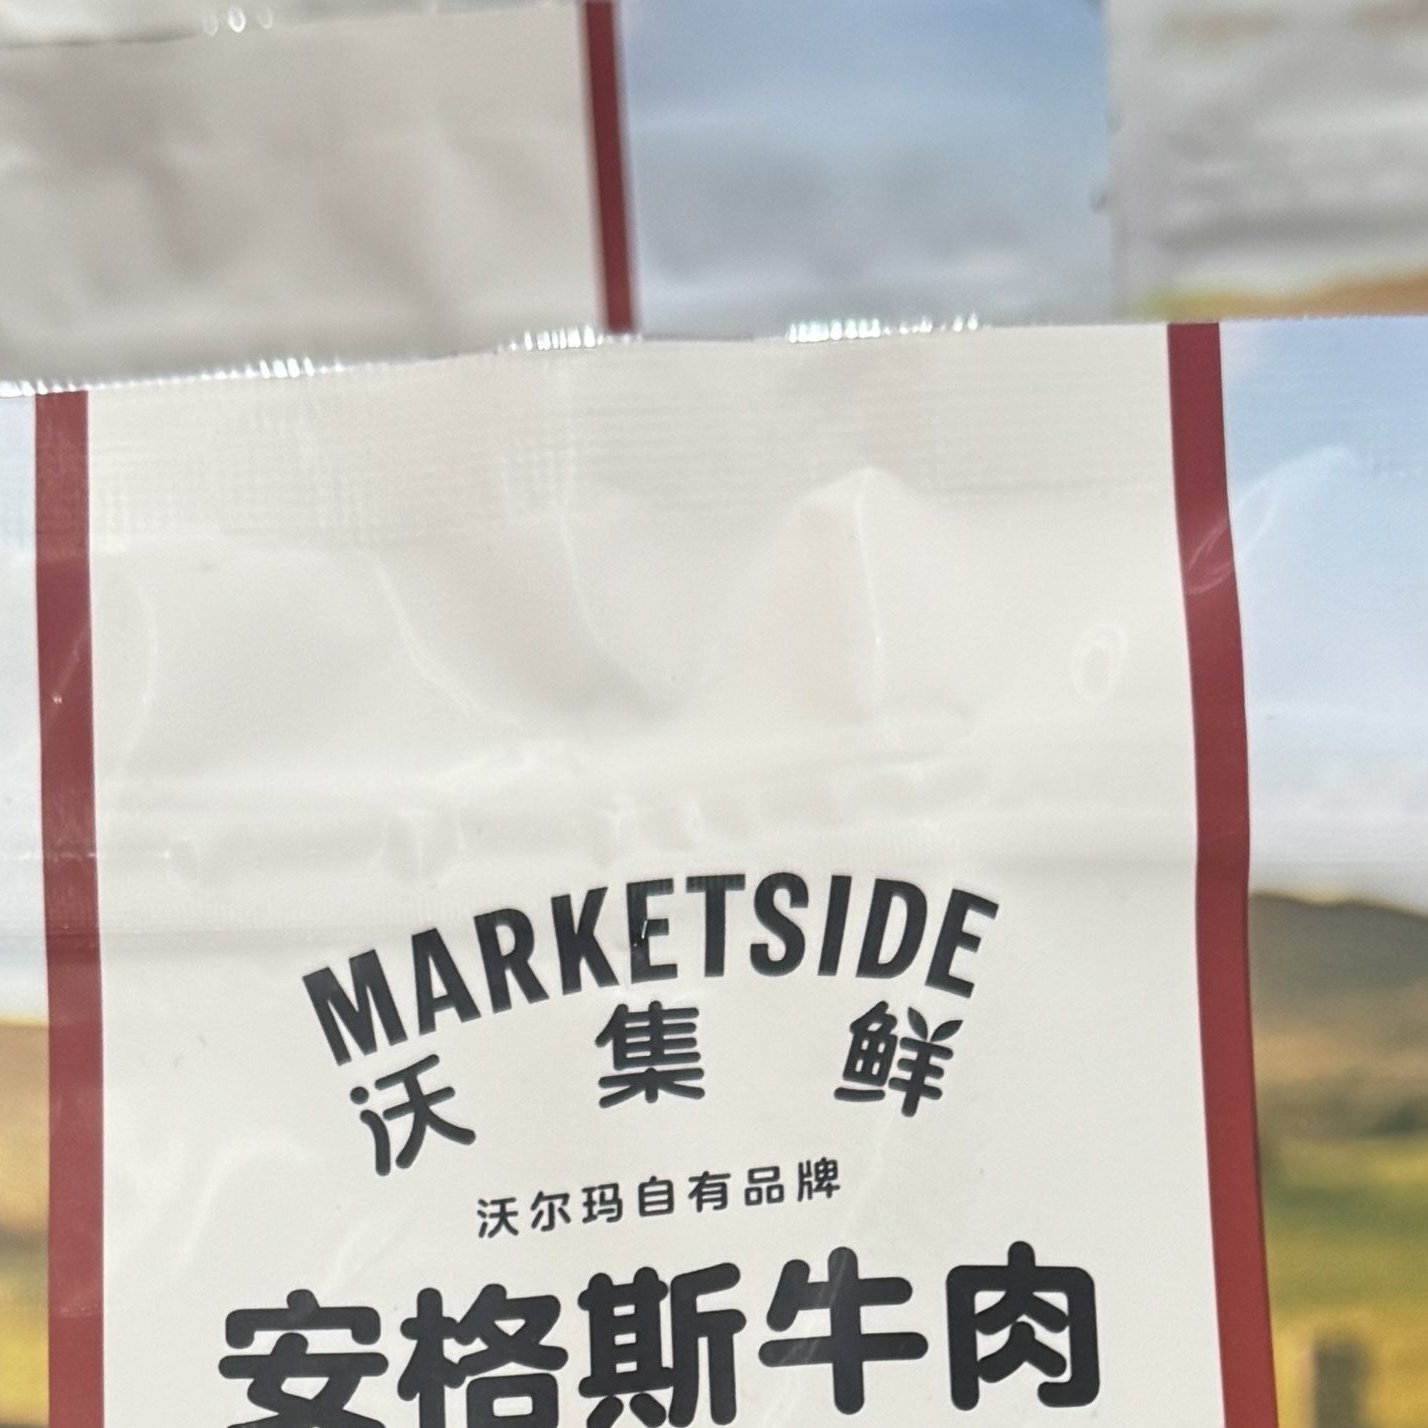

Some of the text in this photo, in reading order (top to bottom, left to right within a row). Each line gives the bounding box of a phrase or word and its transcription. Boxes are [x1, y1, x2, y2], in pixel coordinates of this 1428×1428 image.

[302, 873, 999, 1066] MARKETSIDE
[476, 1157, 842, 1239] 沃尔玛自有品牌
